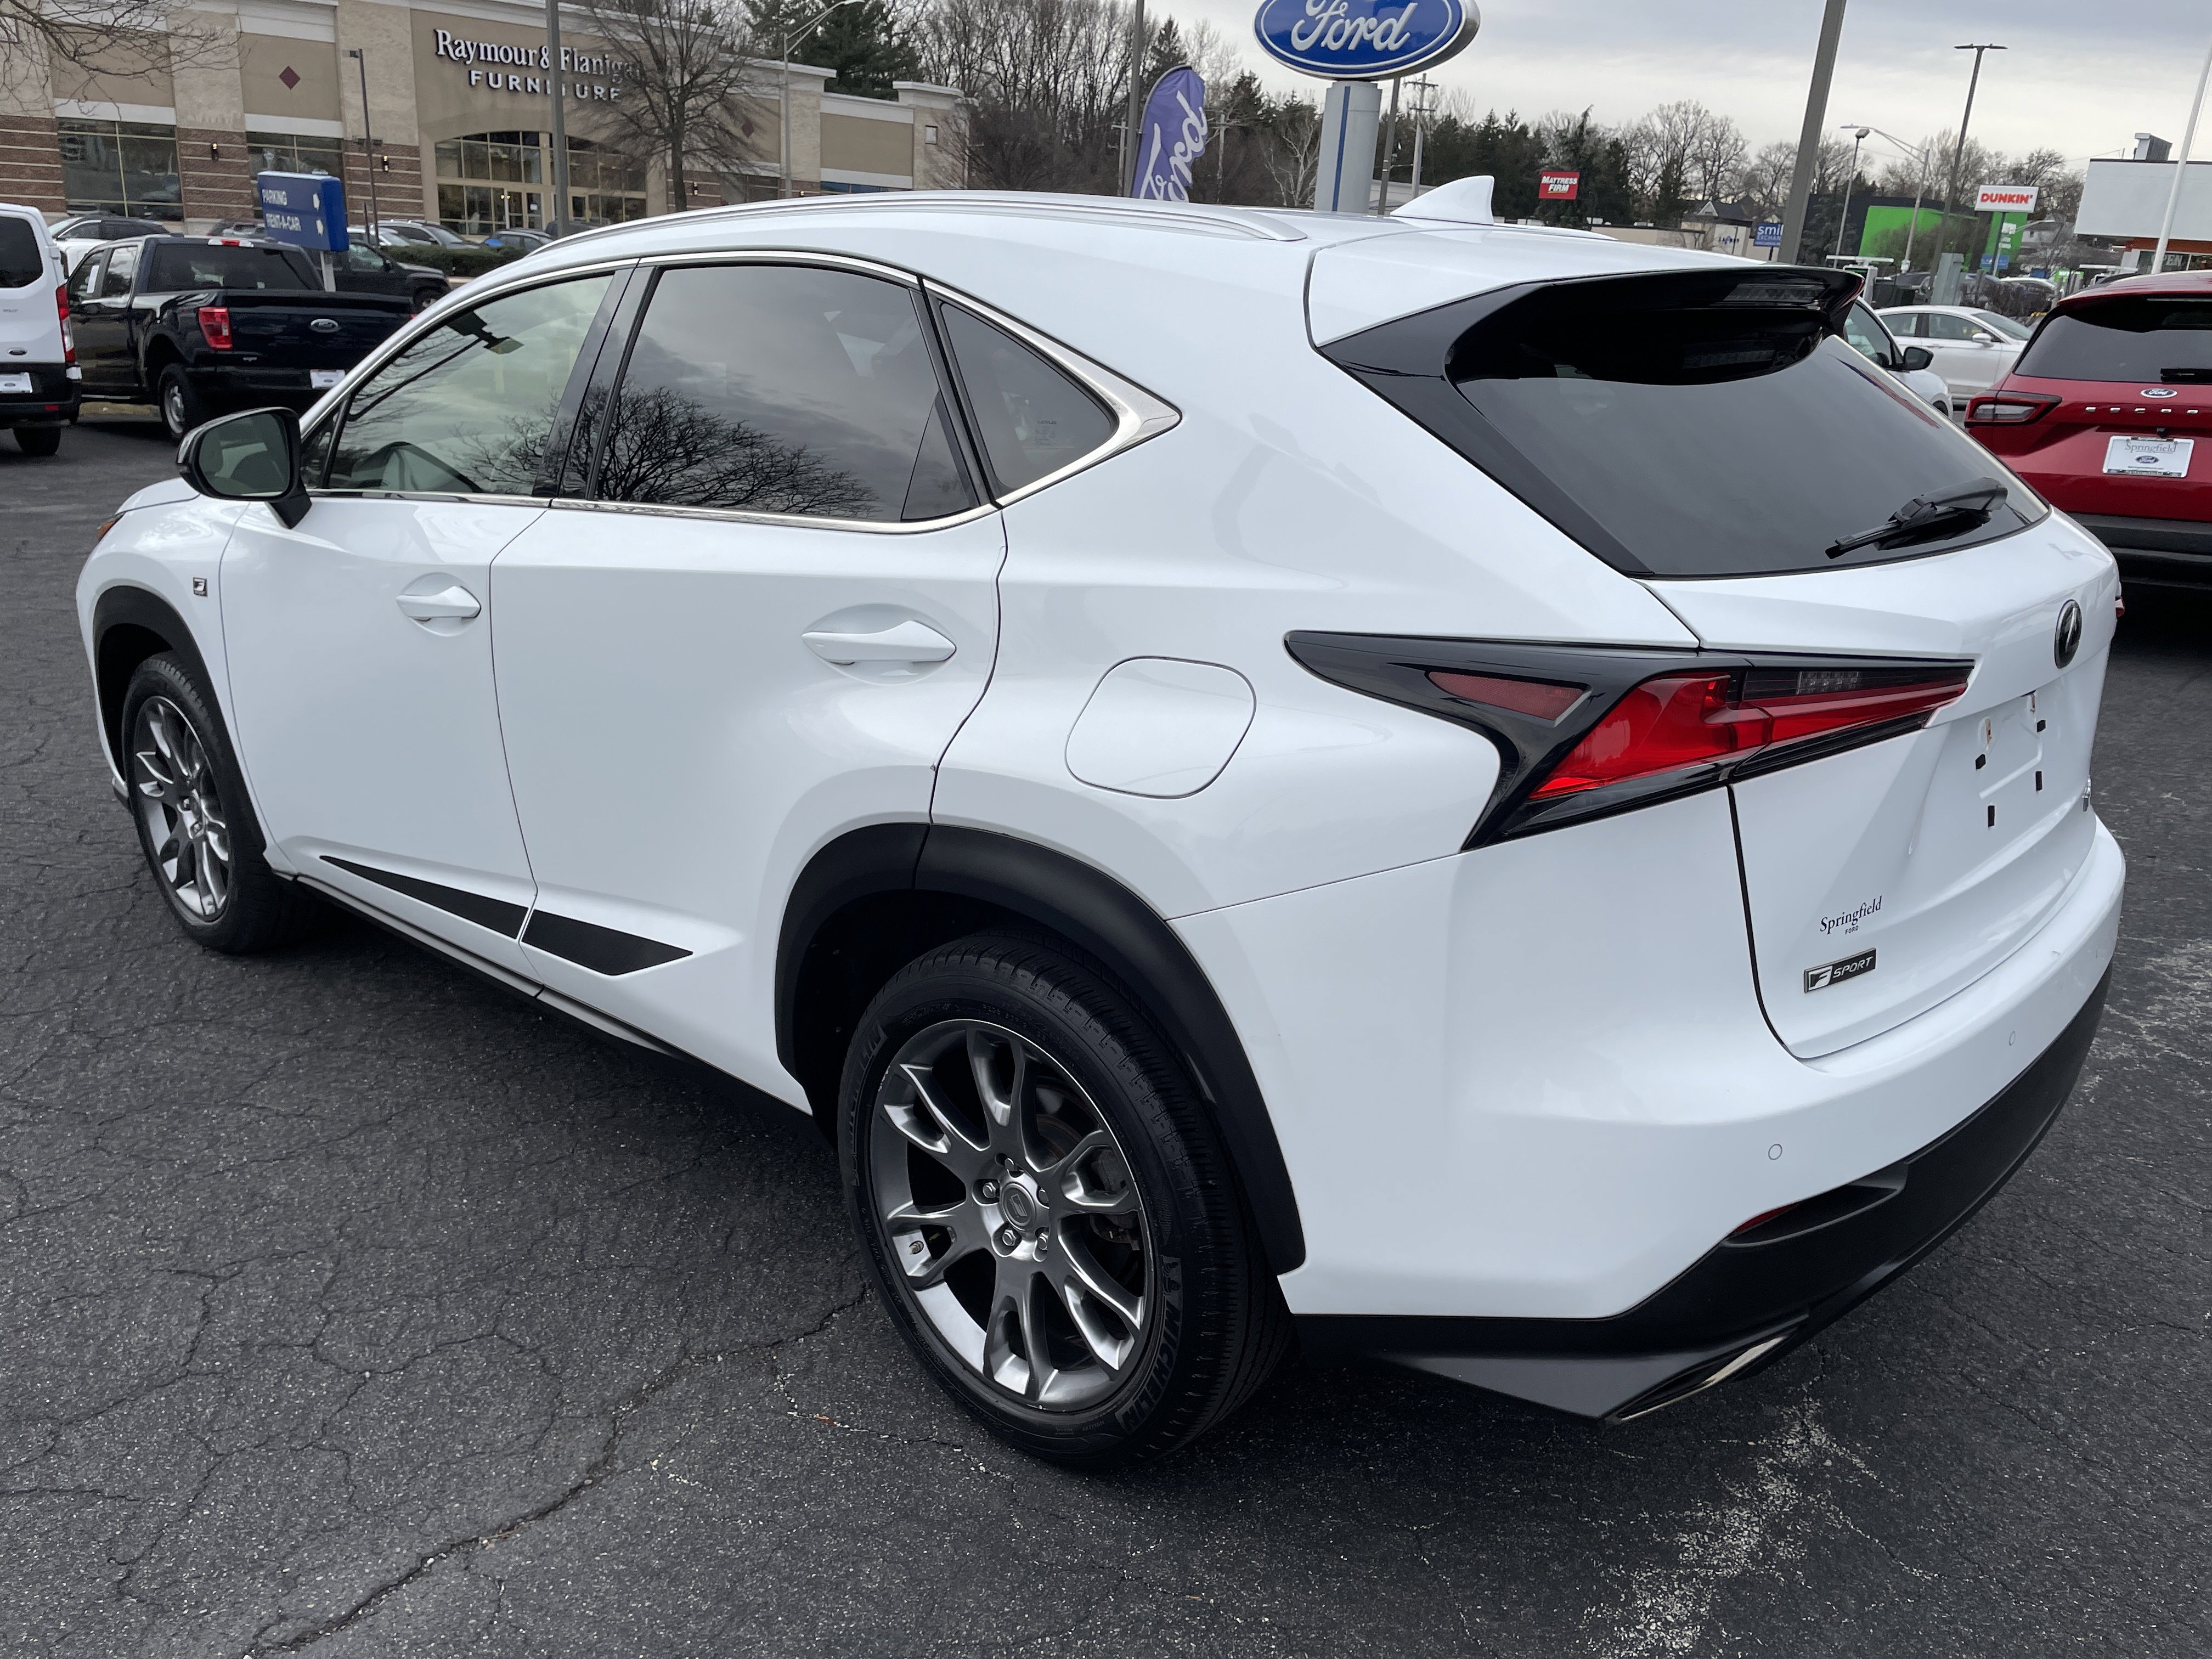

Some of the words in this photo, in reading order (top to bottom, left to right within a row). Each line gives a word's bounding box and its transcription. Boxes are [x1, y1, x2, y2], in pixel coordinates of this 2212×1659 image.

[436, 29, 537, 66] Raymour
[539, 46, 550, 70] &
[1542, 176, 1577, 184] MATTRESS
[262, 188, 287, 206] PARKING
[1980, 194, 2033, 204] DUNKIN'
[2125, 442, 2177, 453] Springfield
[1820, 895, 1882, 935] Springfield
[1844, 926, 1859, 935] FORD
[1832, 956, 1874, 978] SPORT
[1119, 1297, 1182, 1433] MICHELIN
